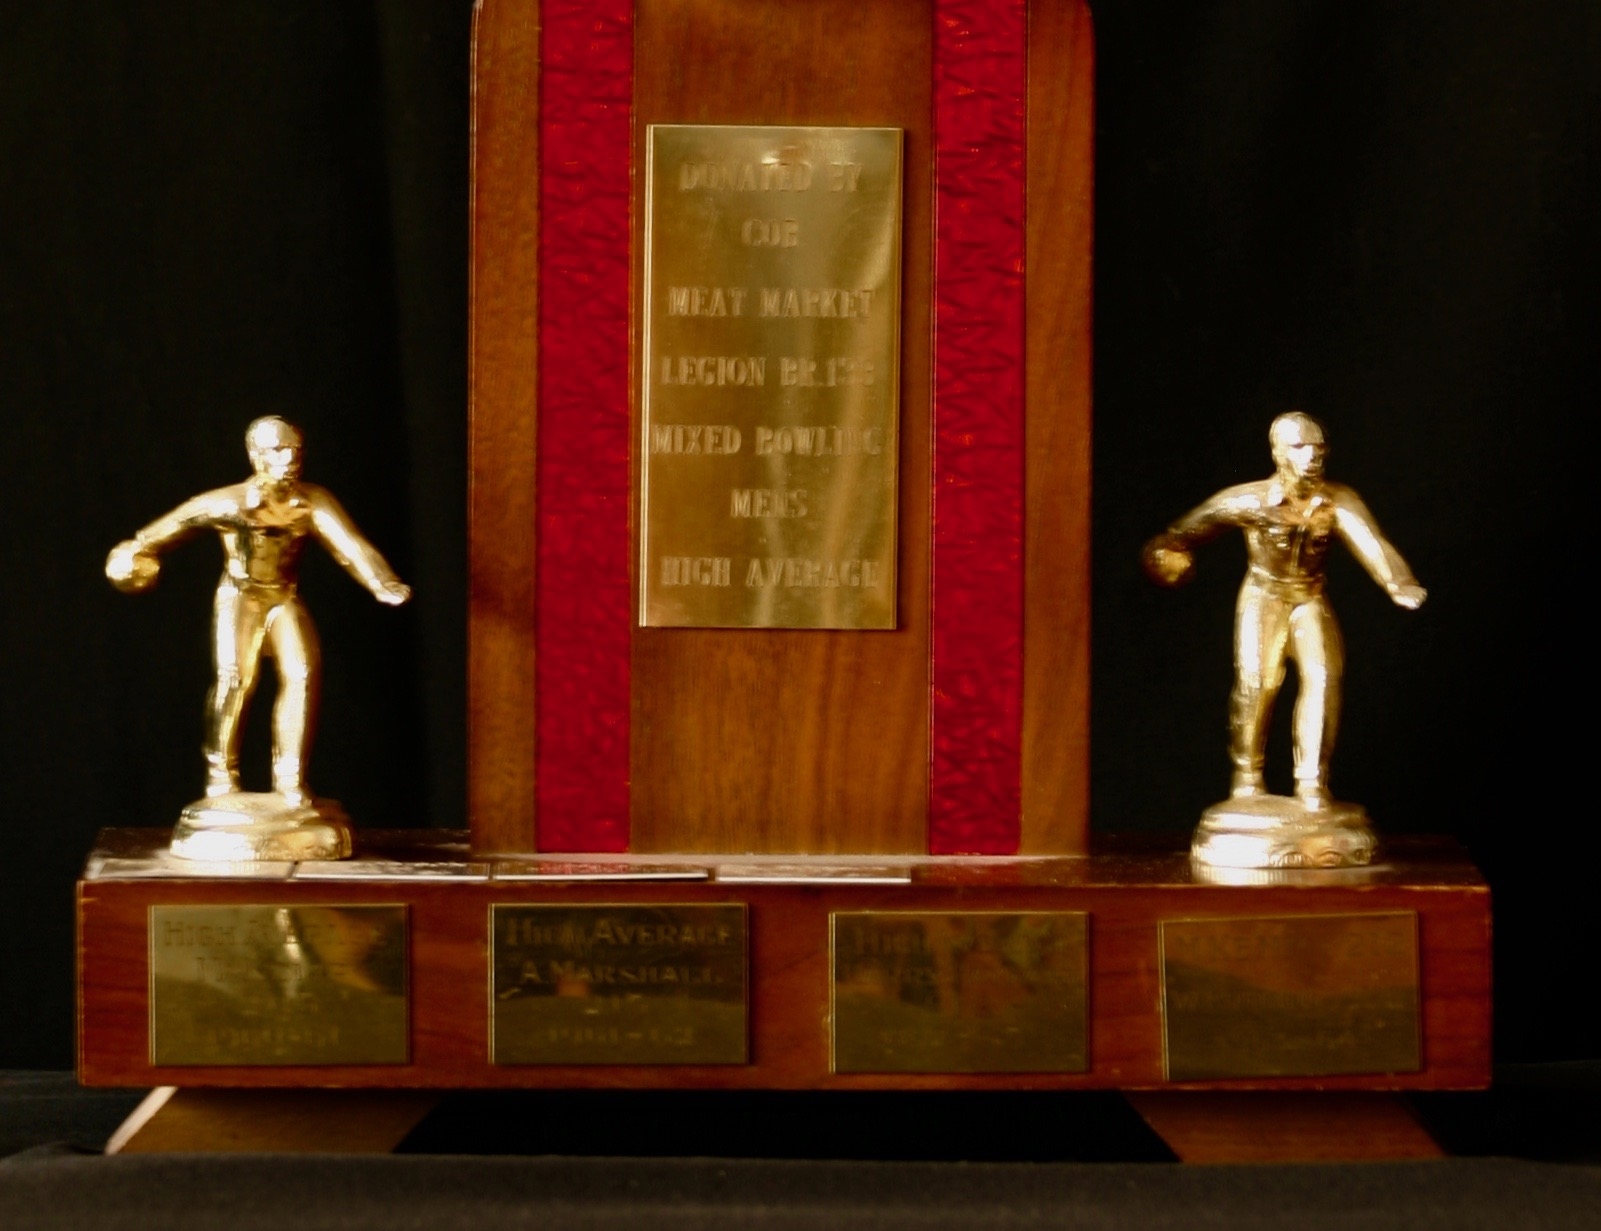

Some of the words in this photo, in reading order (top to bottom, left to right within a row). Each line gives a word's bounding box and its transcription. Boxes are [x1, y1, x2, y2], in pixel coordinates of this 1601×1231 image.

[679, 162, 814, 192] DONATED
[828, 162, 863, 192] BY
[668, 286, 748, 317] MEAT
[760, 286, 875, 318] MARKET
[661, 356, 767, 386] LEGION
[653, 425, 742, 455] MIXED
[755, 426, 882, 456] BOWLING
[661, 556, 731, 586] HIGH
[745, 557, 879, 587] AVERAGE
